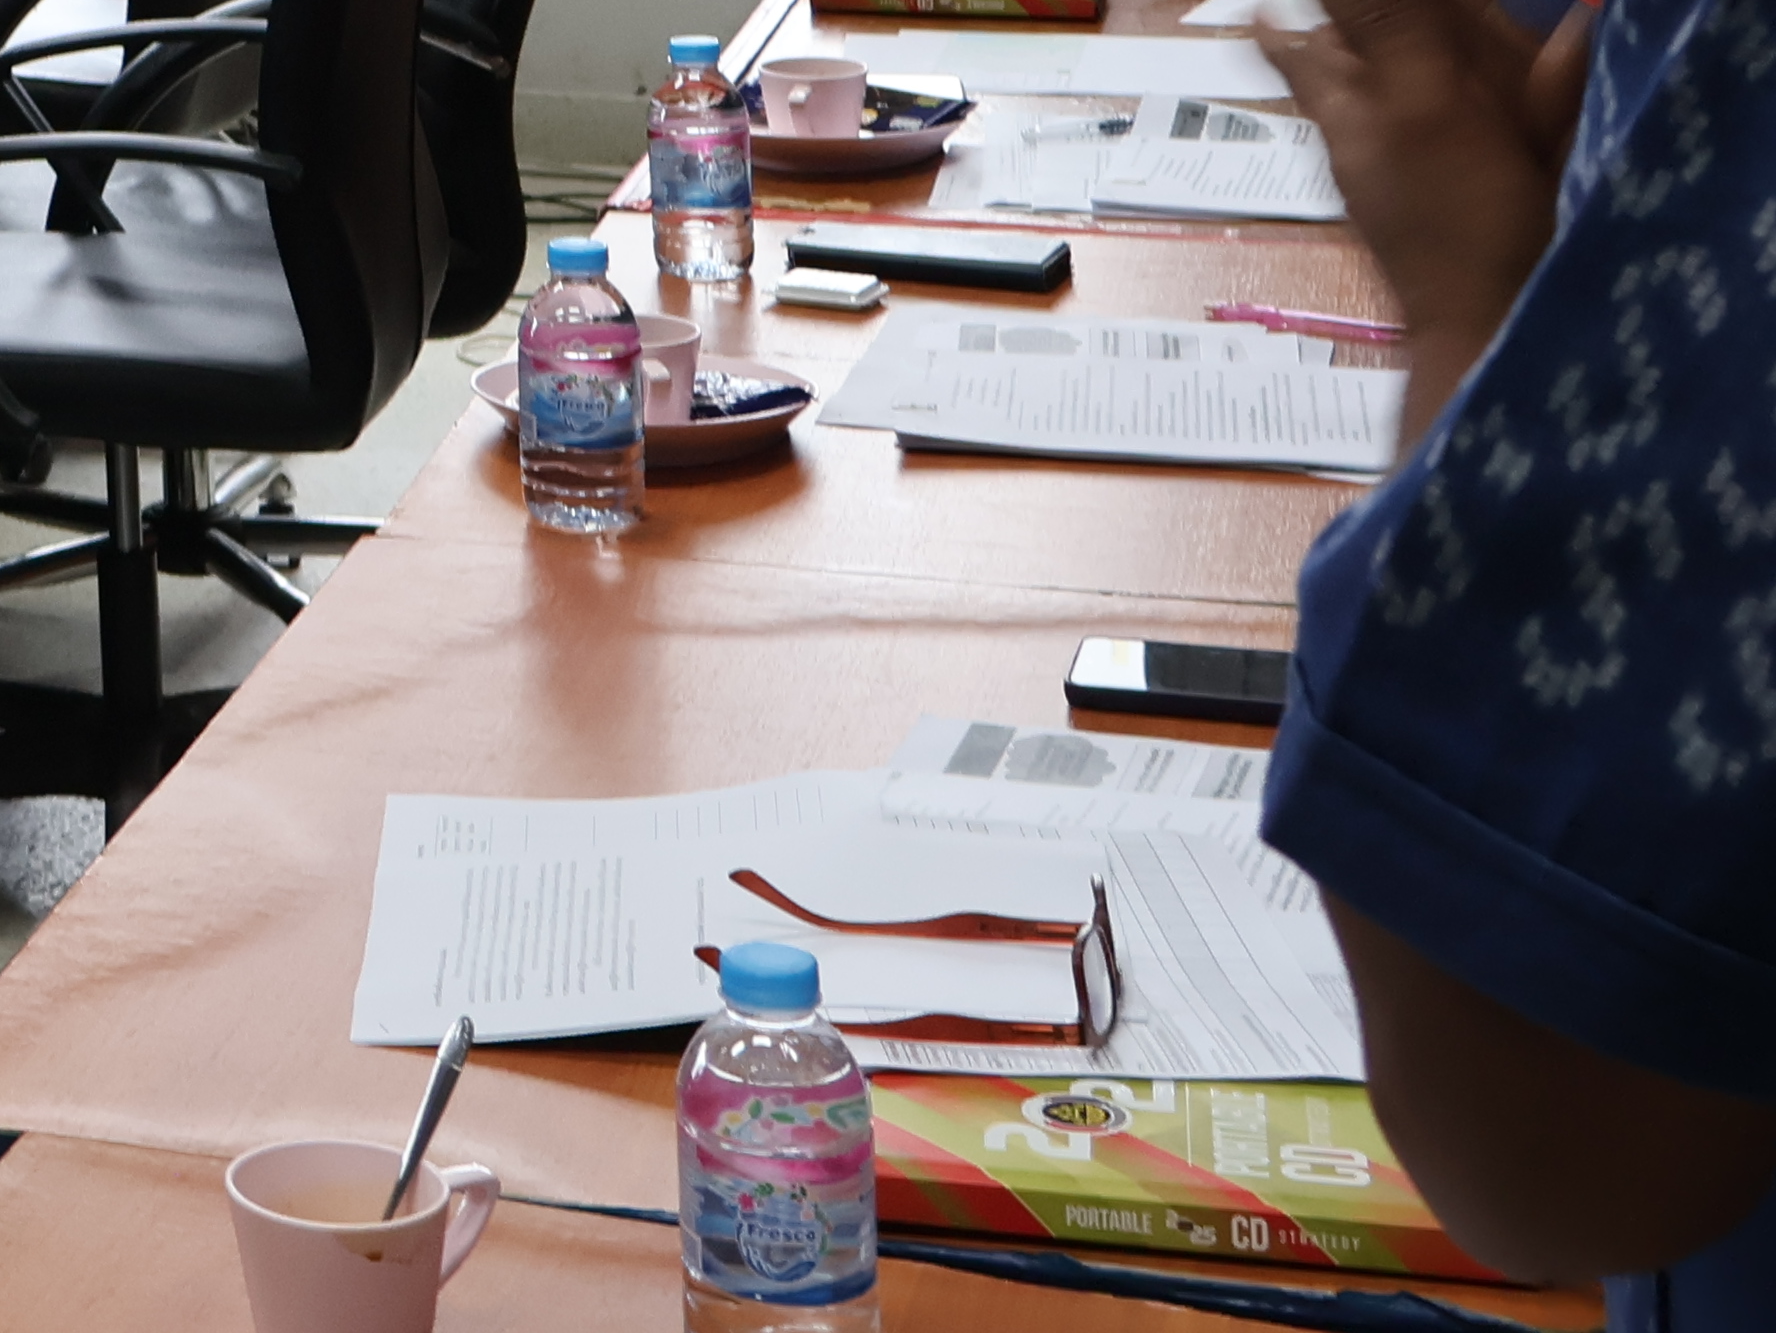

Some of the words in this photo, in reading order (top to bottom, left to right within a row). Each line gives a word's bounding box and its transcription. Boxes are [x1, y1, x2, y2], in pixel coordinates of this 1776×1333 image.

[1279, 1142, 1372, 1187] CD
[1064, 1204, 1153, 1236] PORTABLE
[1230, 1213, 1270, 1252] CD
